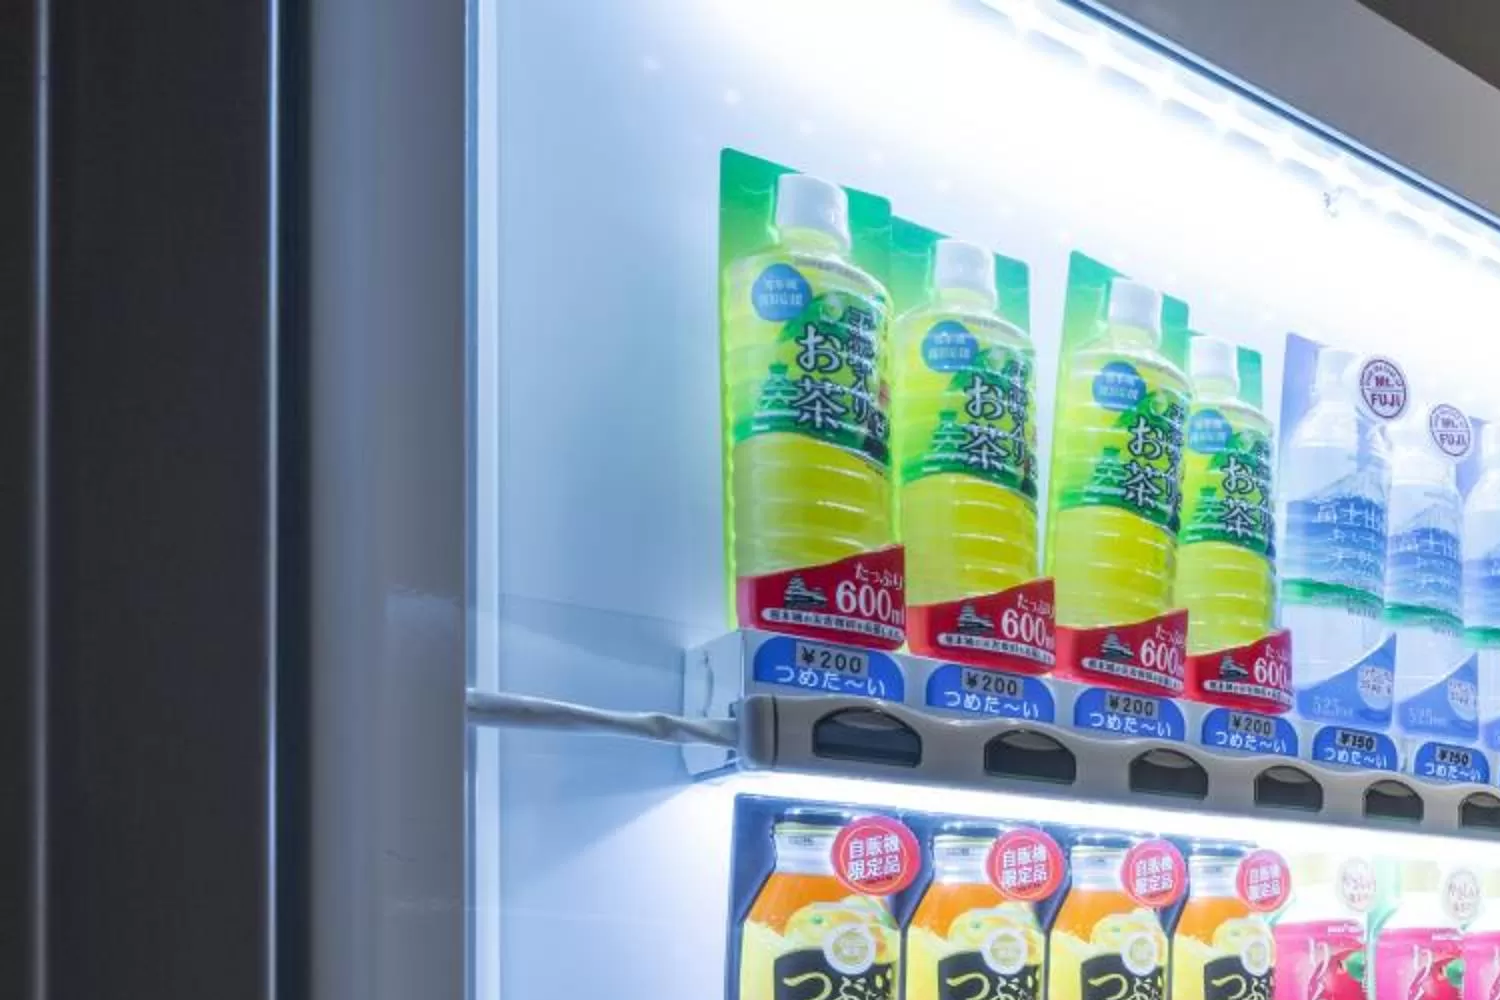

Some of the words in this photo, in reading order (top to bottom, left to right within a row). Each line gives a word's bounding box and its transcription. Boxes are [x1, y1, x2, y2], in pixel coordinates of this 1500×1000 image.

[793, 322, 847, 430] お茶
[962, 374, 1009, 470] お茶
[1124, 416, 1163, 507] お茶
[1223, 457, 1254, 536] お茶
[855, 562, 903, 590] たっぷり
[801, 648, 862, 673] ¥200
[966, 671, 1017, 695] ¥200
[1108, 695, 1155, 717] ¥200
[1232, 715, 1272, 736] ¥200
[849, 834, 900, 859] 自販機
[1003, 843, 1047, 868] 自販機
[847, 856, 900, 881] 限定品
[1002, 864, 1047, 889] 限定品
